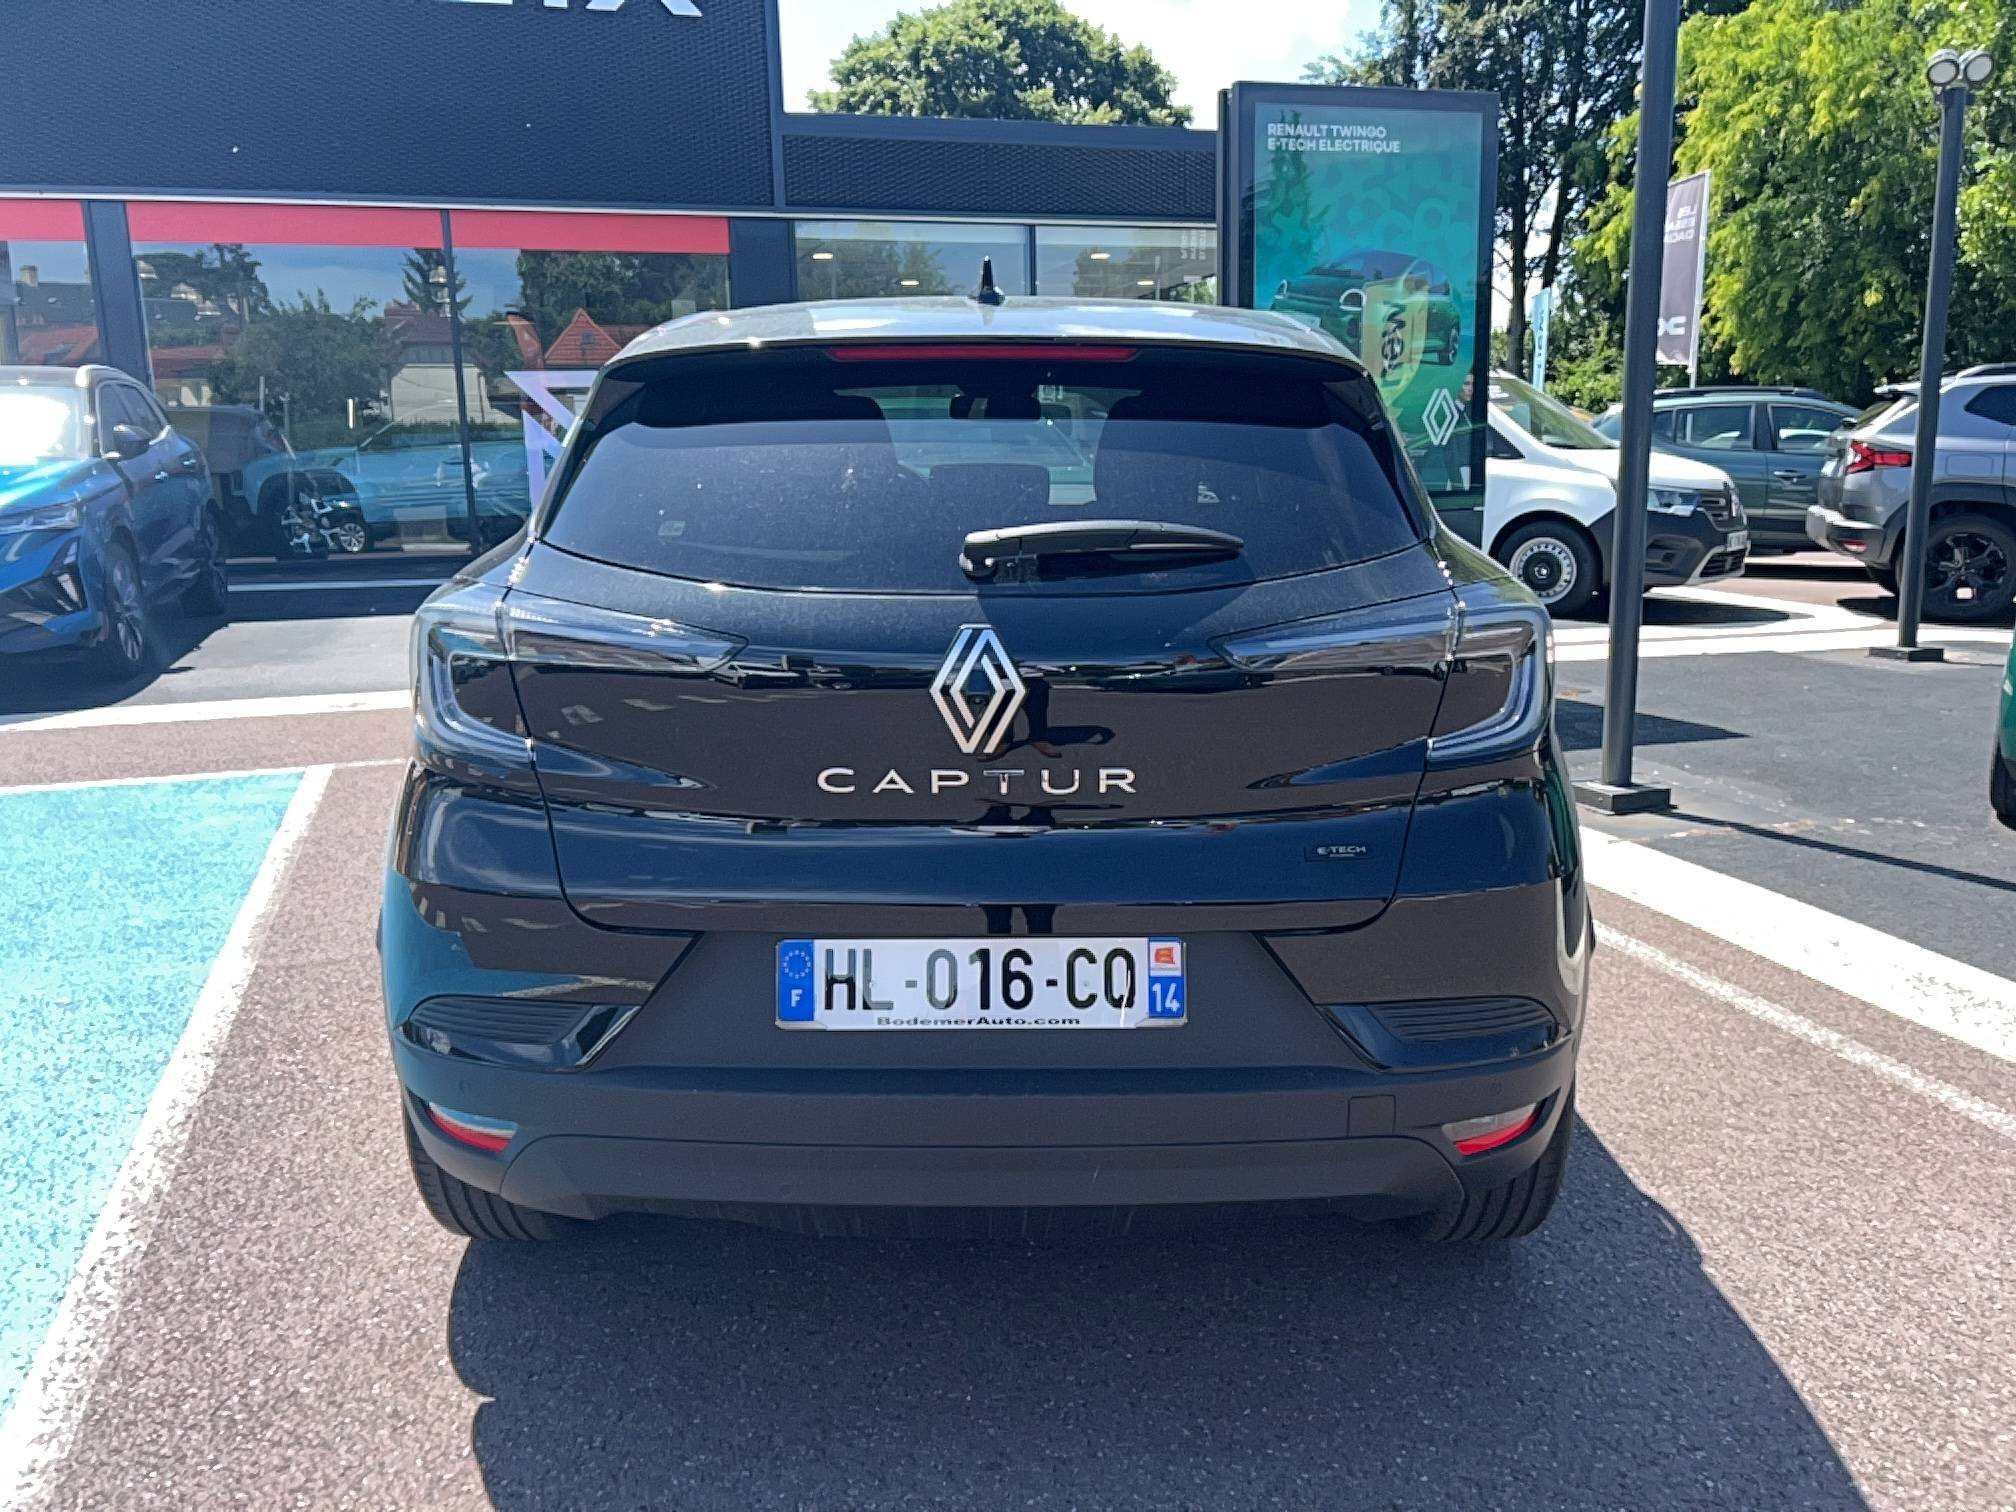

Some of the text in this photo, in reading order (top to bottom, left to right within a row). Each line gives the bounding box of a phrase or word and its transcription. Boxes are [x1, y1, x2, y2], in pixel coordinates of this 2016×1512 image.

[1267, 123, 1387, 139] RENAULT TWINGO
[1267, 137, 1400, 154] E-TECH ELECTRIQUE
[816, 767, 1138, 795] CAPTUR
[1316, 845, 1367, 855] E-TECH
[790, 988, 802, 1007] F
[1151, 982, 1180, 1013] 14
[876, 1015, 1081, 1026] BodemerAuto.com
